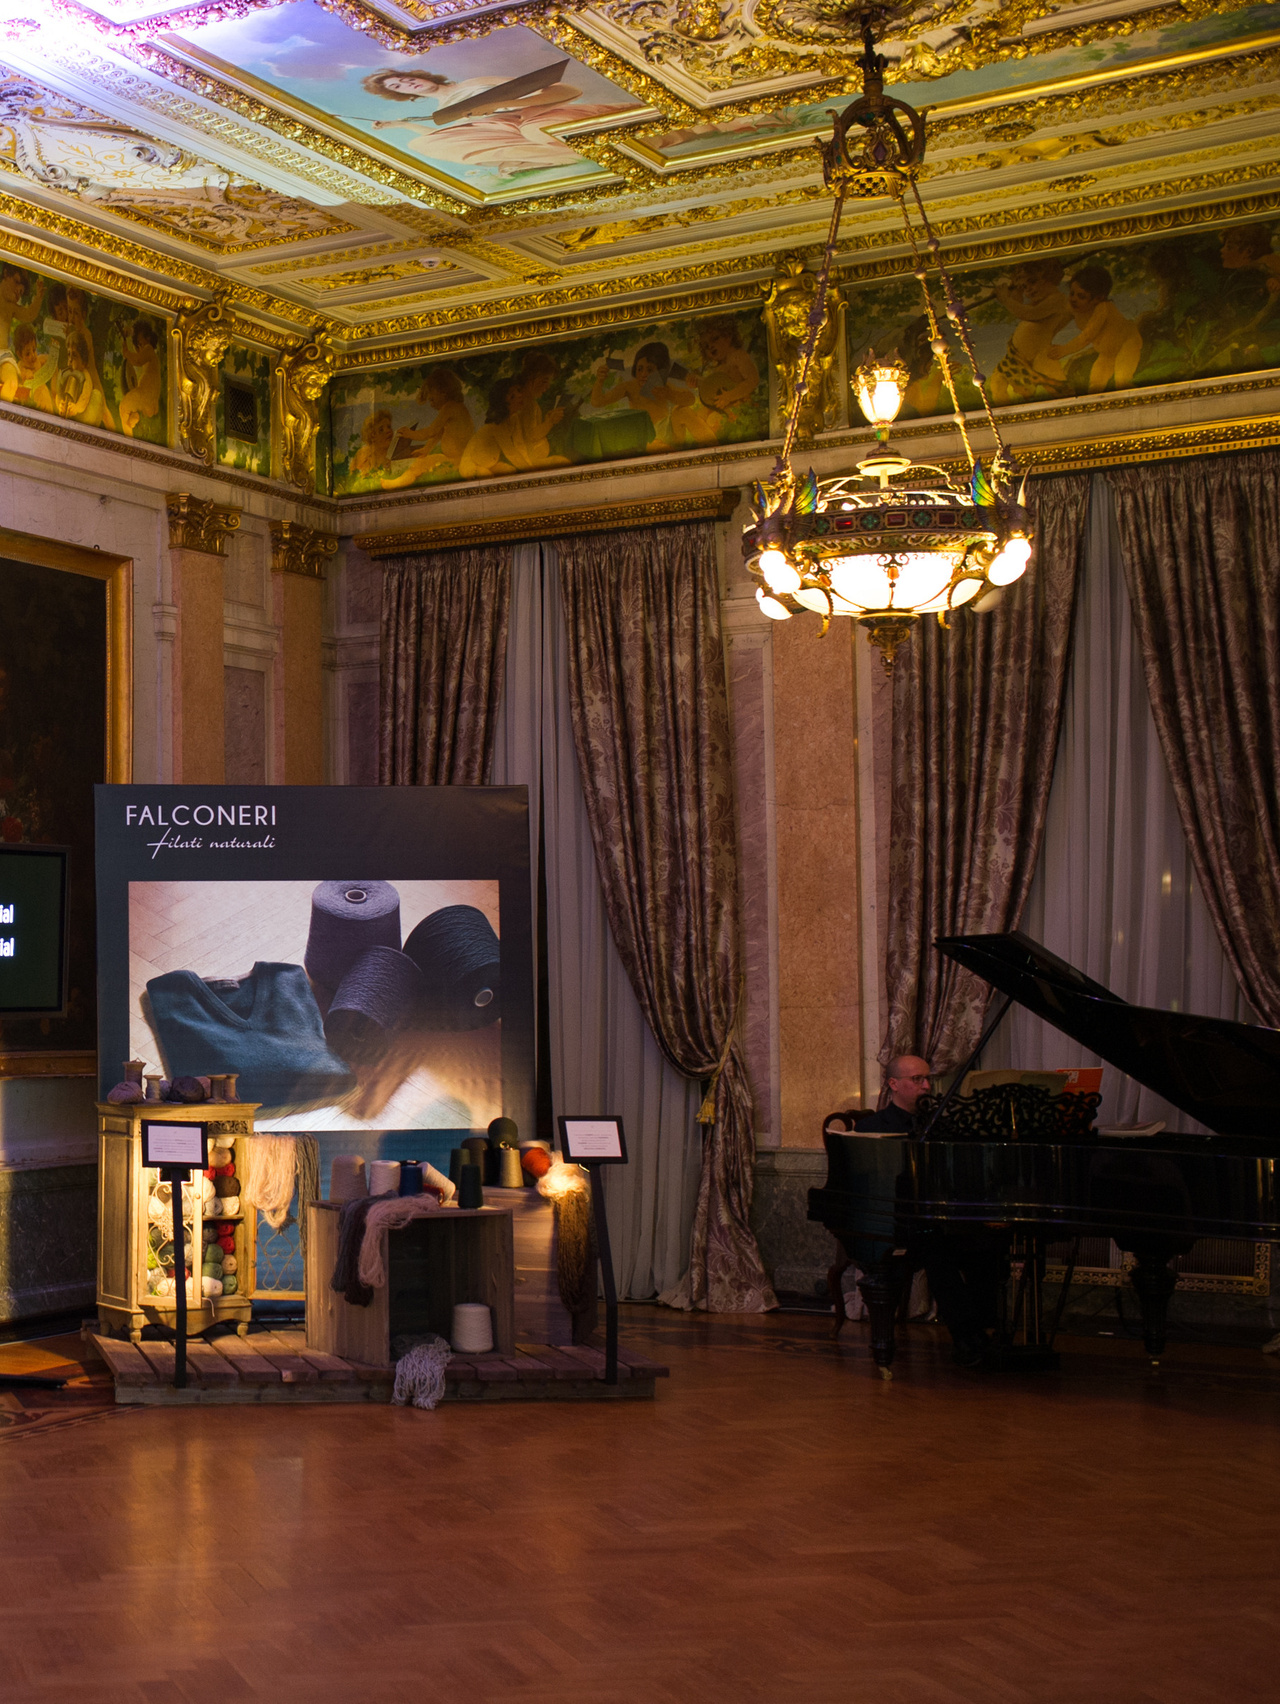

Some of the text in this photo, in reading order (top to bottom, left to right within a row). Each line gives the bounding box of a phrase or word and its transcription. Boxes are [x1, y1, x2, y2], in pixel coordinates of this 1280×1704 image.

[125, 804, 277, 826] FALCONERI
[146, 827, 276, 859] filati naturali
